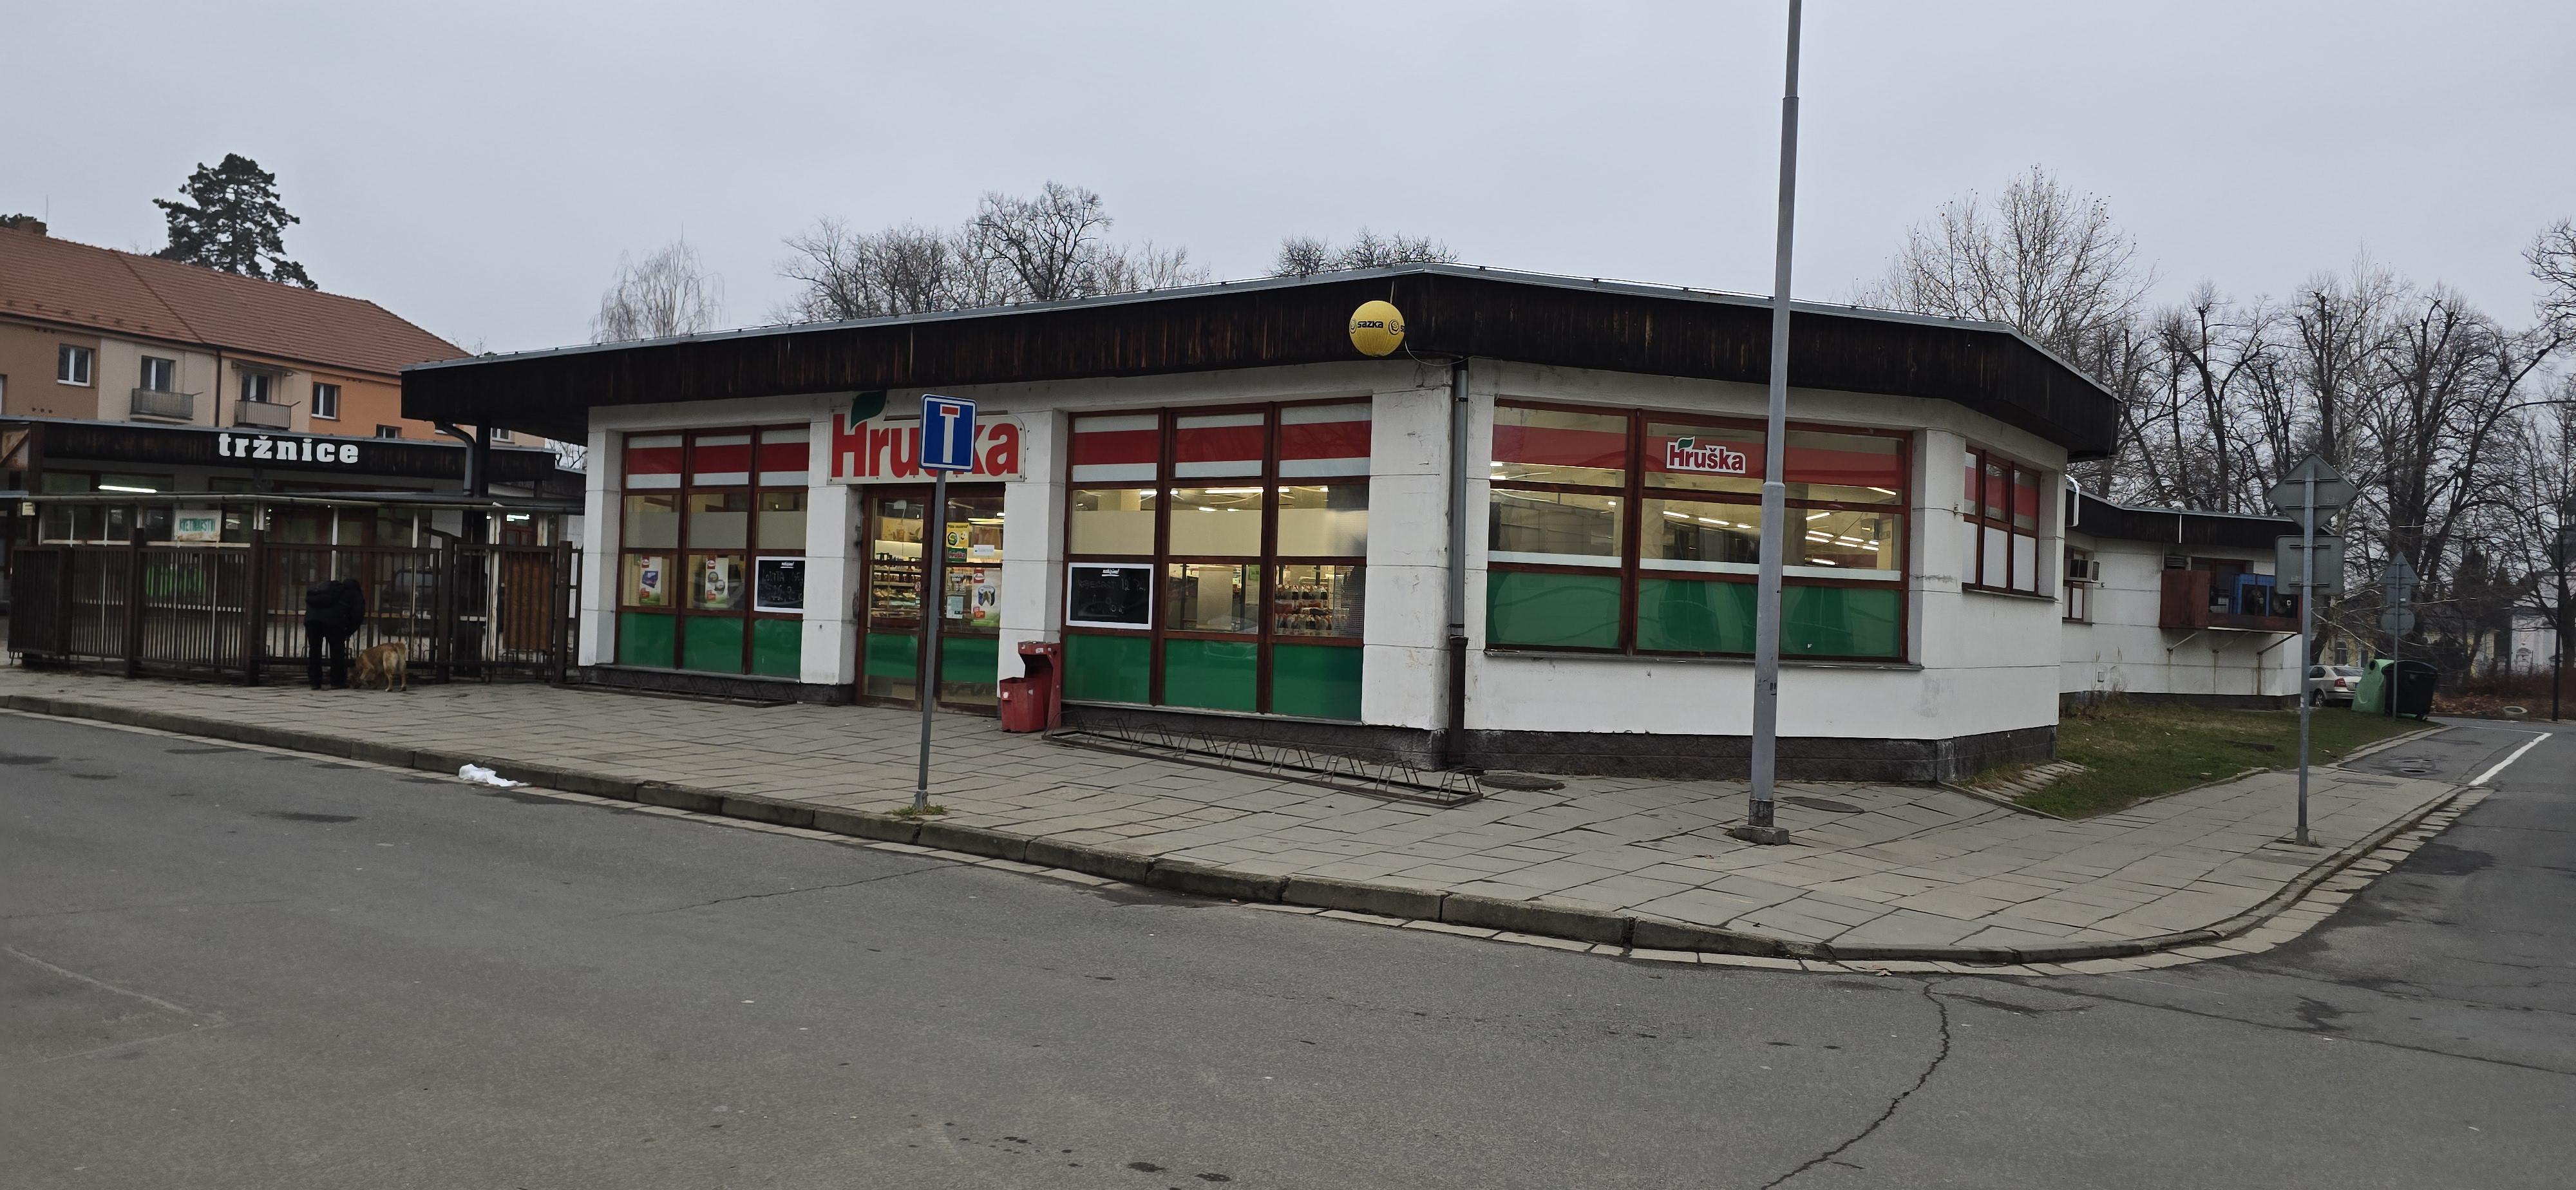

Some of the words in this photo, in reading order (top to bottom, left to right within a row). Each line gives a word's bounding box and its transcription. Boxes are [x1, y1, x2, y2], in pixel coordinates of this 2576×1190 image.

[218, 433, 359, 464] tržnice
[831, 413, 1019, 478] Hrua
[1669, 444, 1744, 471] Hruška
